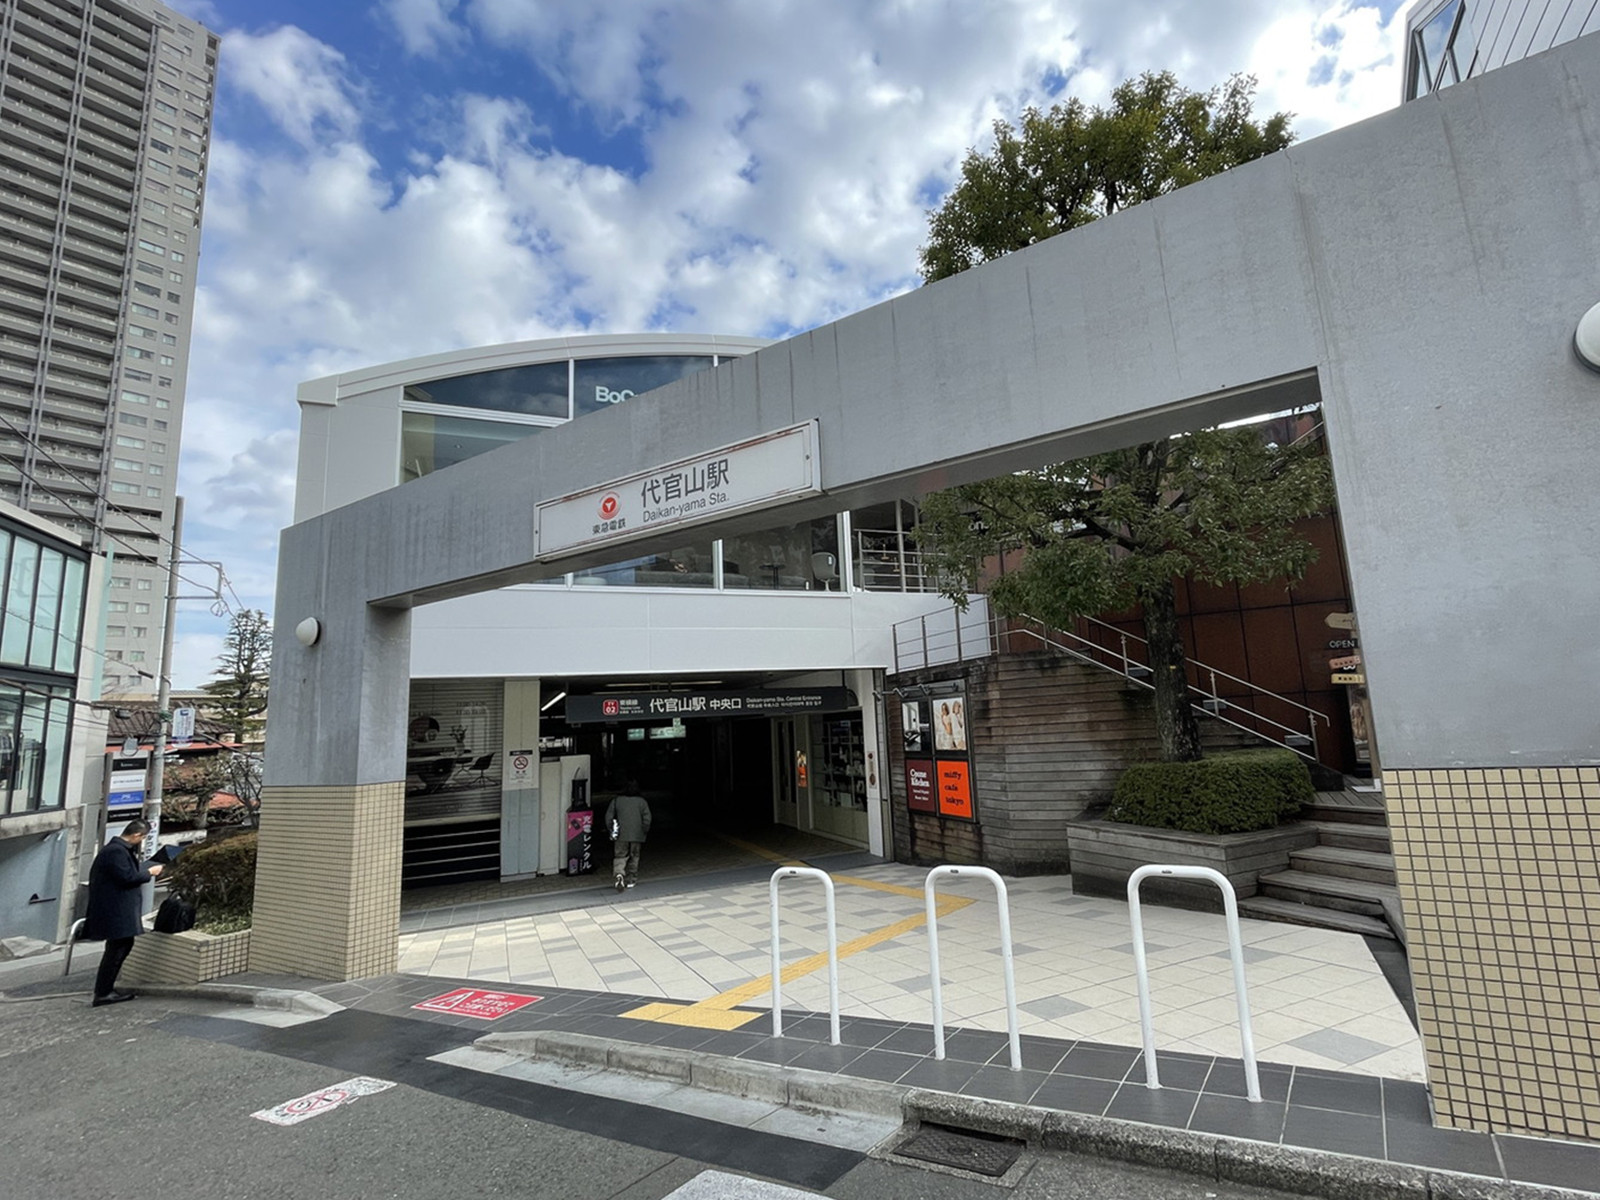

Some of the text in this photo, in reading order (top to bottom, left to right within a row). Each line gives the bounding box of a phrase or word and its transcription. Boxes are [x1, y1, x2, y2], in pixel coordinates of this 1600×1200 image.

[641, 458, 729, 507] 代官山駅
[643, 491, 729, 523] Daikan-yama Sta.
[592, 518, 626, 534] 東急電鉄
[1329, 640, 1355, 648] OPEN
[649, 697, 742, 713] 代官山駅 中央口
[944, 771, 961, 780] miffy
[946, 796, 964, 805] tokyo
